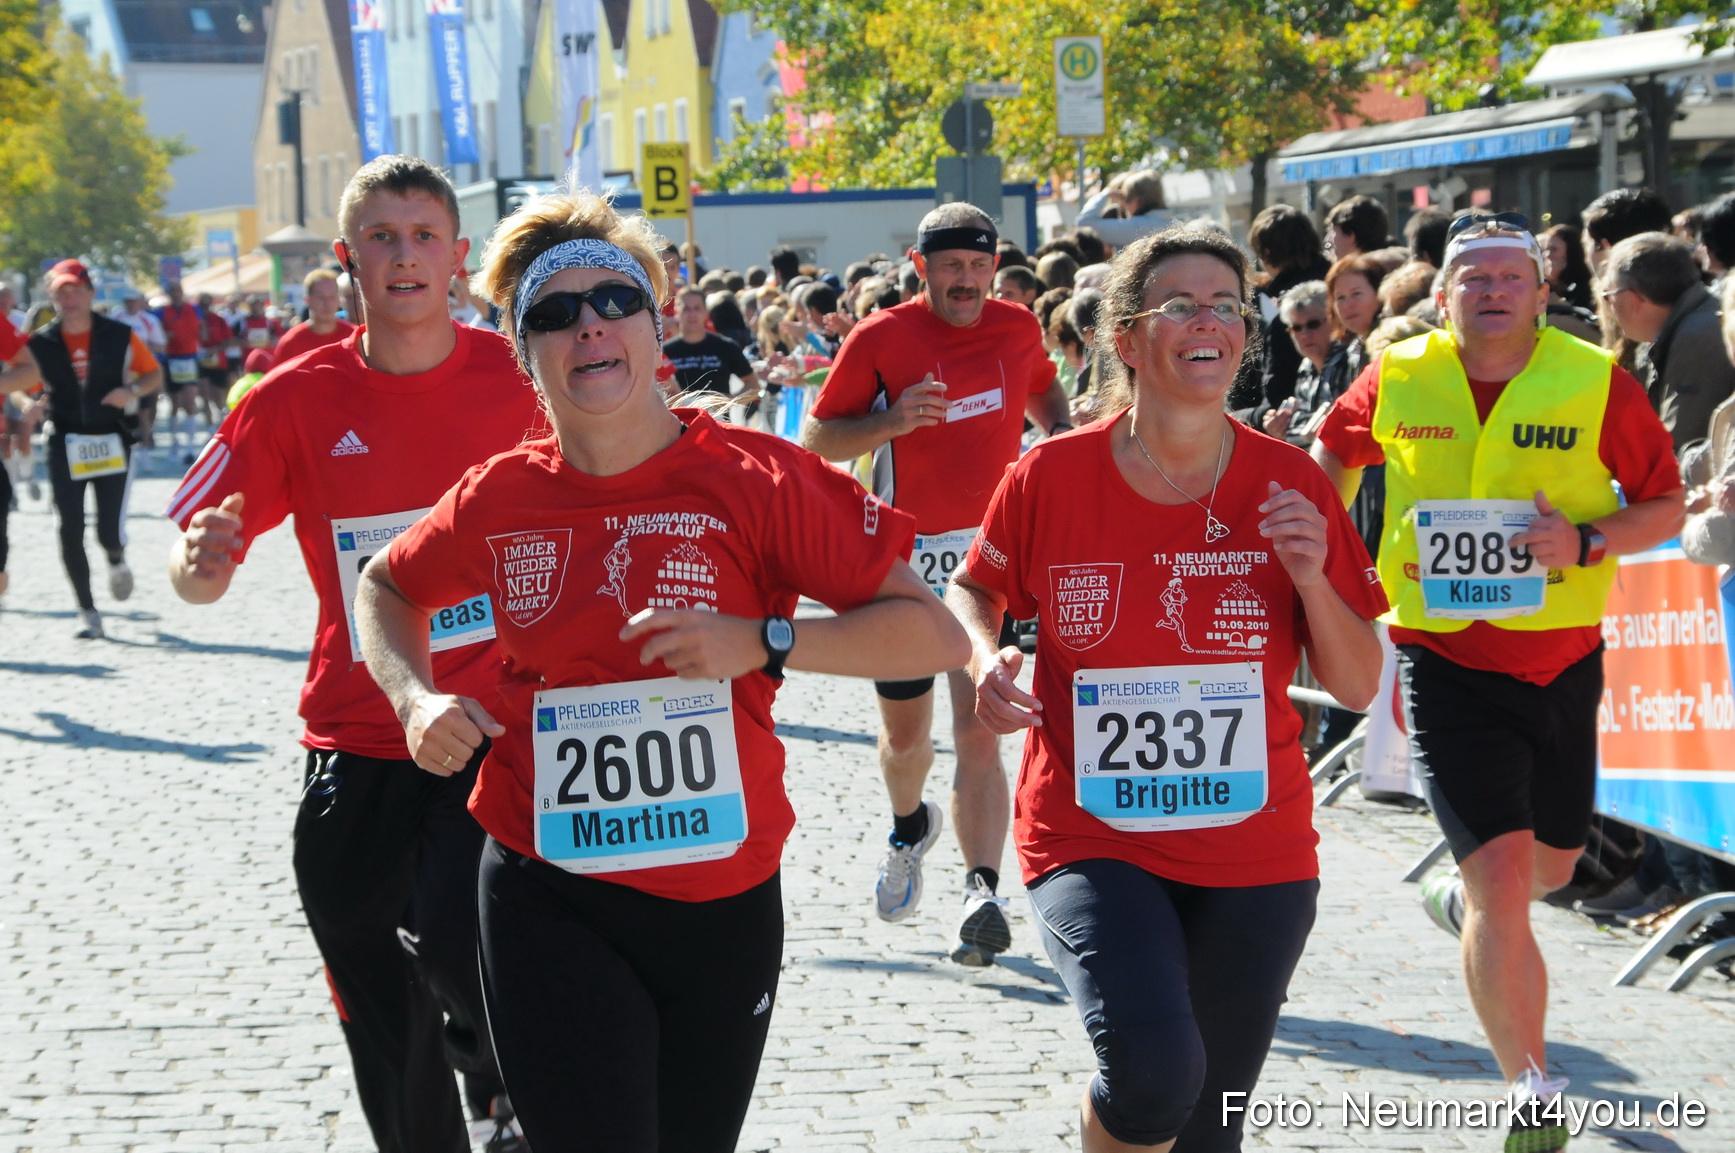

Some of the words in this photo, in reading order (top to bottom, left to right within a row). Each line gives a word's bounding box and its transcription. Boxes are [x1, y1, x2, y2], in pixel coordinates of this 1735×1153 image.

[655, 166, 679, 201] B
[961, 398, 988, 413] DEHN
[1513, 423, 1578, 451] UHU
[331, 444, 369, 456] adidas
[604, 516, 624, 530] 11.
[627, 512, 727, 533] NEUMARKTER
[1433, 510, 1488, 521] PFLEIDERER
[621, 522, 705, 539] STADTLAUF
[504, 542, 556, 560] IMMER
[983, 539, 1008, 567] ERER
[1153, 553, 1172, 565] 11.
[1175, 551, 1268, 565] NEUMARKTER
[1430, 531, 1533, 575] 2989
[504, 556, 557, 576] WIEDER
[920, 550, 969, 584] 29
[1172, 563, 1252, 577] STADTLAUF
[506, 572, 552, 597] NEU
[1058, 575, 1108, 590] IMMER
[1450, 580, 1512, 603] Klaus
[655, 584, 717, 600] 19.09.2010
[1057, 588, 1110, 603] WIEDER
[506, 594, 549, 612] MARKT
[429, 599, 486, 632] reas
[1058, 602, 1104, 623] NEU
[1058, 623, 1103, 637] MARKT
[1212, 620, 1269, 630] 19.09.2010
[1624, 613, 1657, 649] aus
[1101, 681, 1181, 697] PFLEIDERER
[1200, 681, 1248, 695] BOCK
[558, 699, 641, 721] PFLEIDERER
[663, 694, 714, 712] BOCK
[1102, 696, 1181, 706] AKTIENGESELLSCHAFT
[560, 716, 642, 731] AKTIENGESELLSCHAFT
[1096, 708, 1243, 771] 2337
[556, 724, 717, 806] 2600
[1083, 763, 1091, 774] C
[543, 797, 550, 810] B
[1115, 776, 1231, 815] Brigitte
[571, 805, 710, 849] Martina
